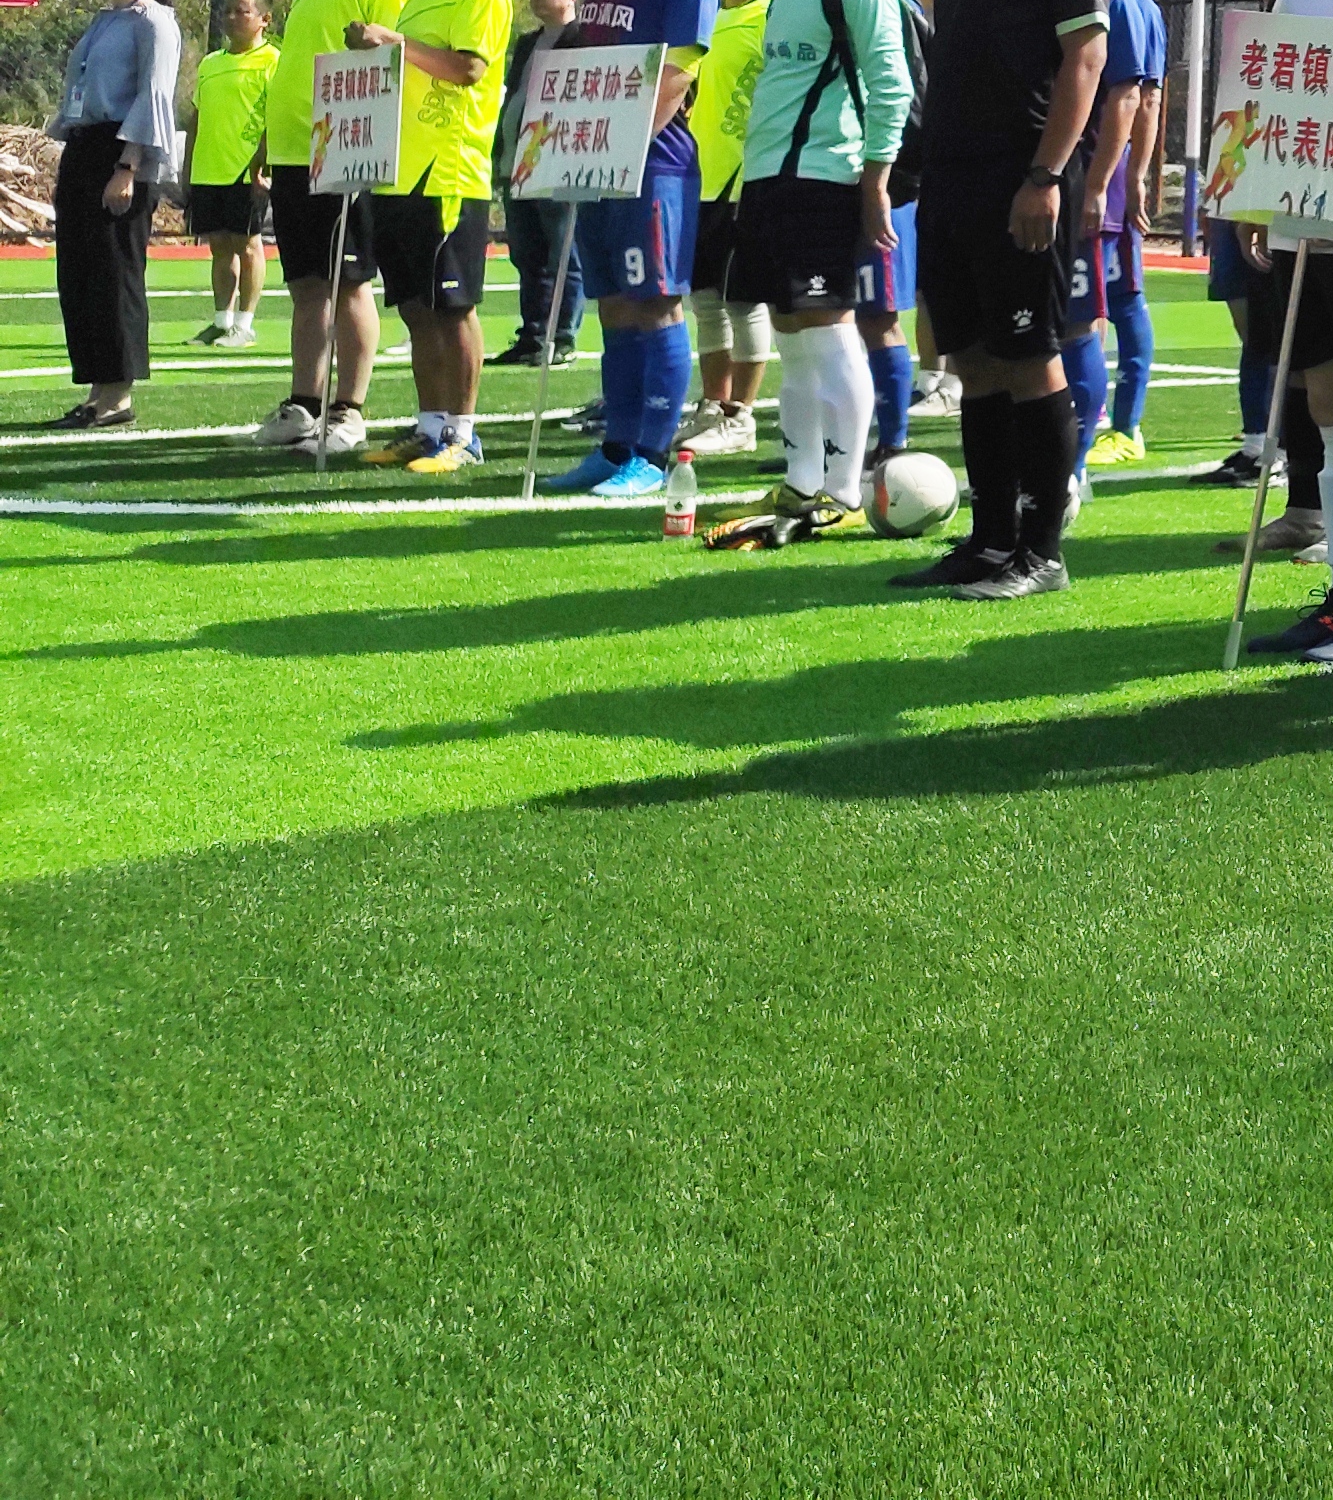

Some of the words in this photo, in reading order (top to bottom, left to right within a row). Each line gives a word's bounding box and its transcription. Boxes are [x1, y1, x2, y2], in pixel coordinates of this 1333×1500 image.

[540, 64, 643, 103] 区足球协会
[339, 114, 373, 151] 代表队
[552, 116, 611, 155] 代表队
[624, 246, 645, 286] 9
